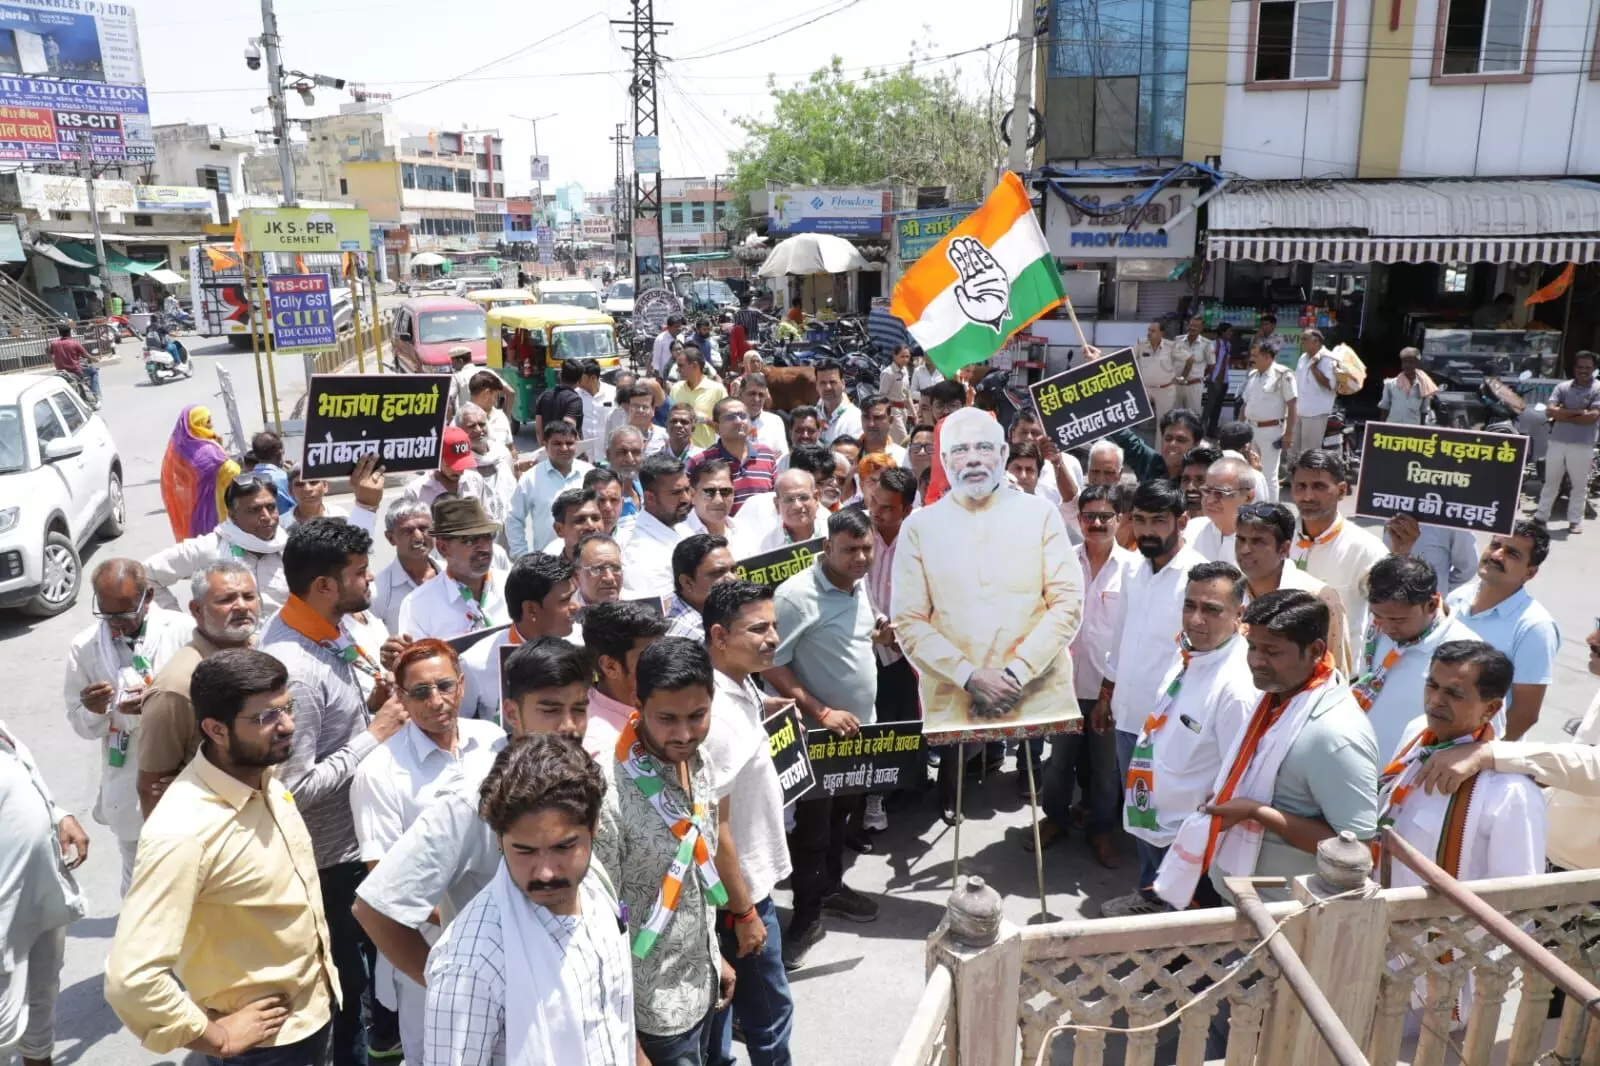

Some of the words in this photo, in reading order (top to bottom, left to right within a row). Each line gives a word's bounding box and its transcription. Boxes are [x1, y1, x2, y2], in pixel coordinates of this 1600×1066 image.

[108, 4, 131, 16] LTD.
[28, 80, 145, 100] EDUCATION
[57, 112, 117, 129] RS-CIT
[264, 222, 283, 234] JK
[902, 220, 920, 237] श्री
[279, 236, 321, 244] CEMENT
[1070, 231, 1169, 248] PROVISION
[275, 279, 324, 292] RS-CIT
[273, 295, 302, 310] Tally
[305, 293, 328, 306] GST
[276, 309, 329, 328] CIIT
[278, 325, 332, 338] EDUCATION
[318, 392, 380, 418] भाजपा
[381, 383, 440, 422] हटाओ
[1038, 383, 1063, 416] ईडी
[1060, 384, 1080, 404] का
[1056, 412, 1107, 446] इस्तेमाल
[1105, 398, 1126, 423] बंद
[1122, 390, 1140, 420] हो
[383, 426, 438, 460] बचाओ
[1372, 432, 1438, 458] भाजपाई
[1497, 440, 1517, 463] के
[1407, 460, 1472, 488] खिलाफ
[1372, 492, 1416, 512] न्याय
[1418, 492, 1443, 516] की
[1445, 500, 1499, 527] लड़ाई
[749, 567, 770, 585] का
[768, 715, 796, 757] टाओ
[826, 735, 836, 758] के
[854, 732, 863, 756] से
[864, 738, 872, 753] न
[778, 750, 808, 790] चाओ
[823, 772, 845, 796] राहुल
[845, 763, 866, 786] गांधी
[873, 767, 900, 784] आजाद
